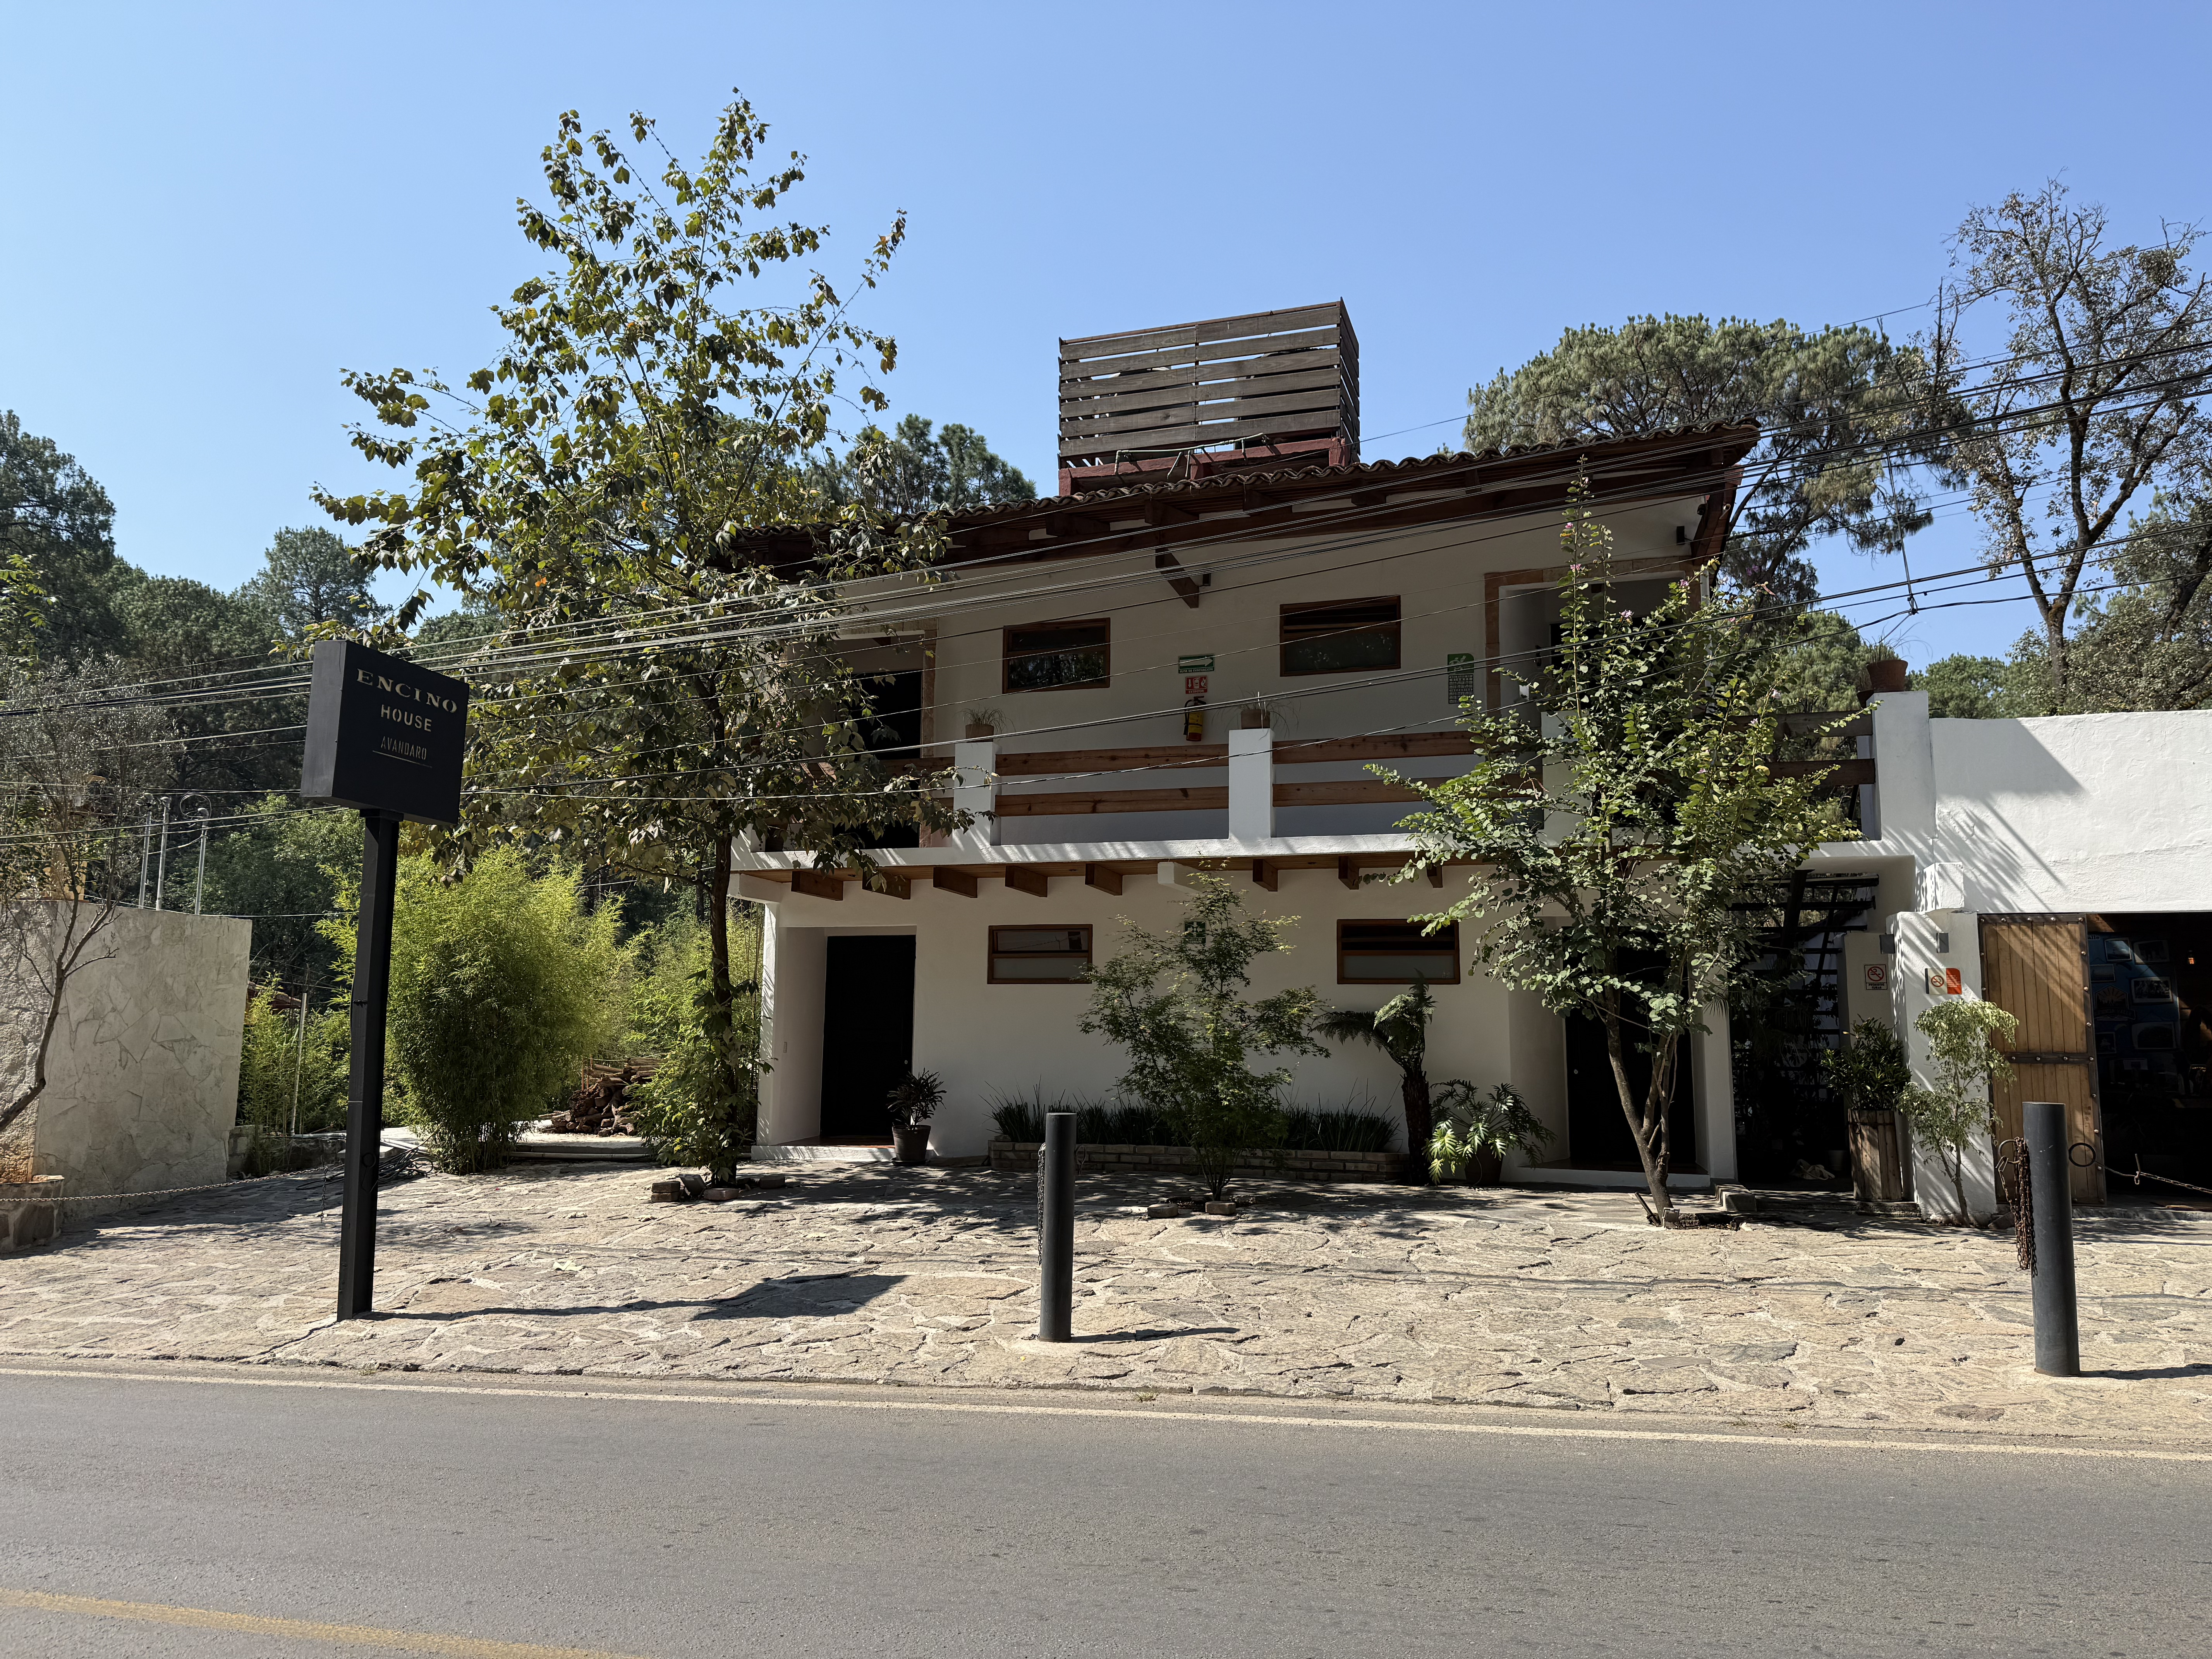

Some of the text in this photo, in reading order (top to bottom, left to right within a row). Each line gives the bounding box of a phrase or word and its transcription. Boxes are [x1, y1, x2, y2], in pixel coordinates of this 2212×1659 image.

[356, 668, 458, 713] ENCINO
[380, 704, 432, 732] HOUSE
[380, 736, 427, 761] AVANDARO
